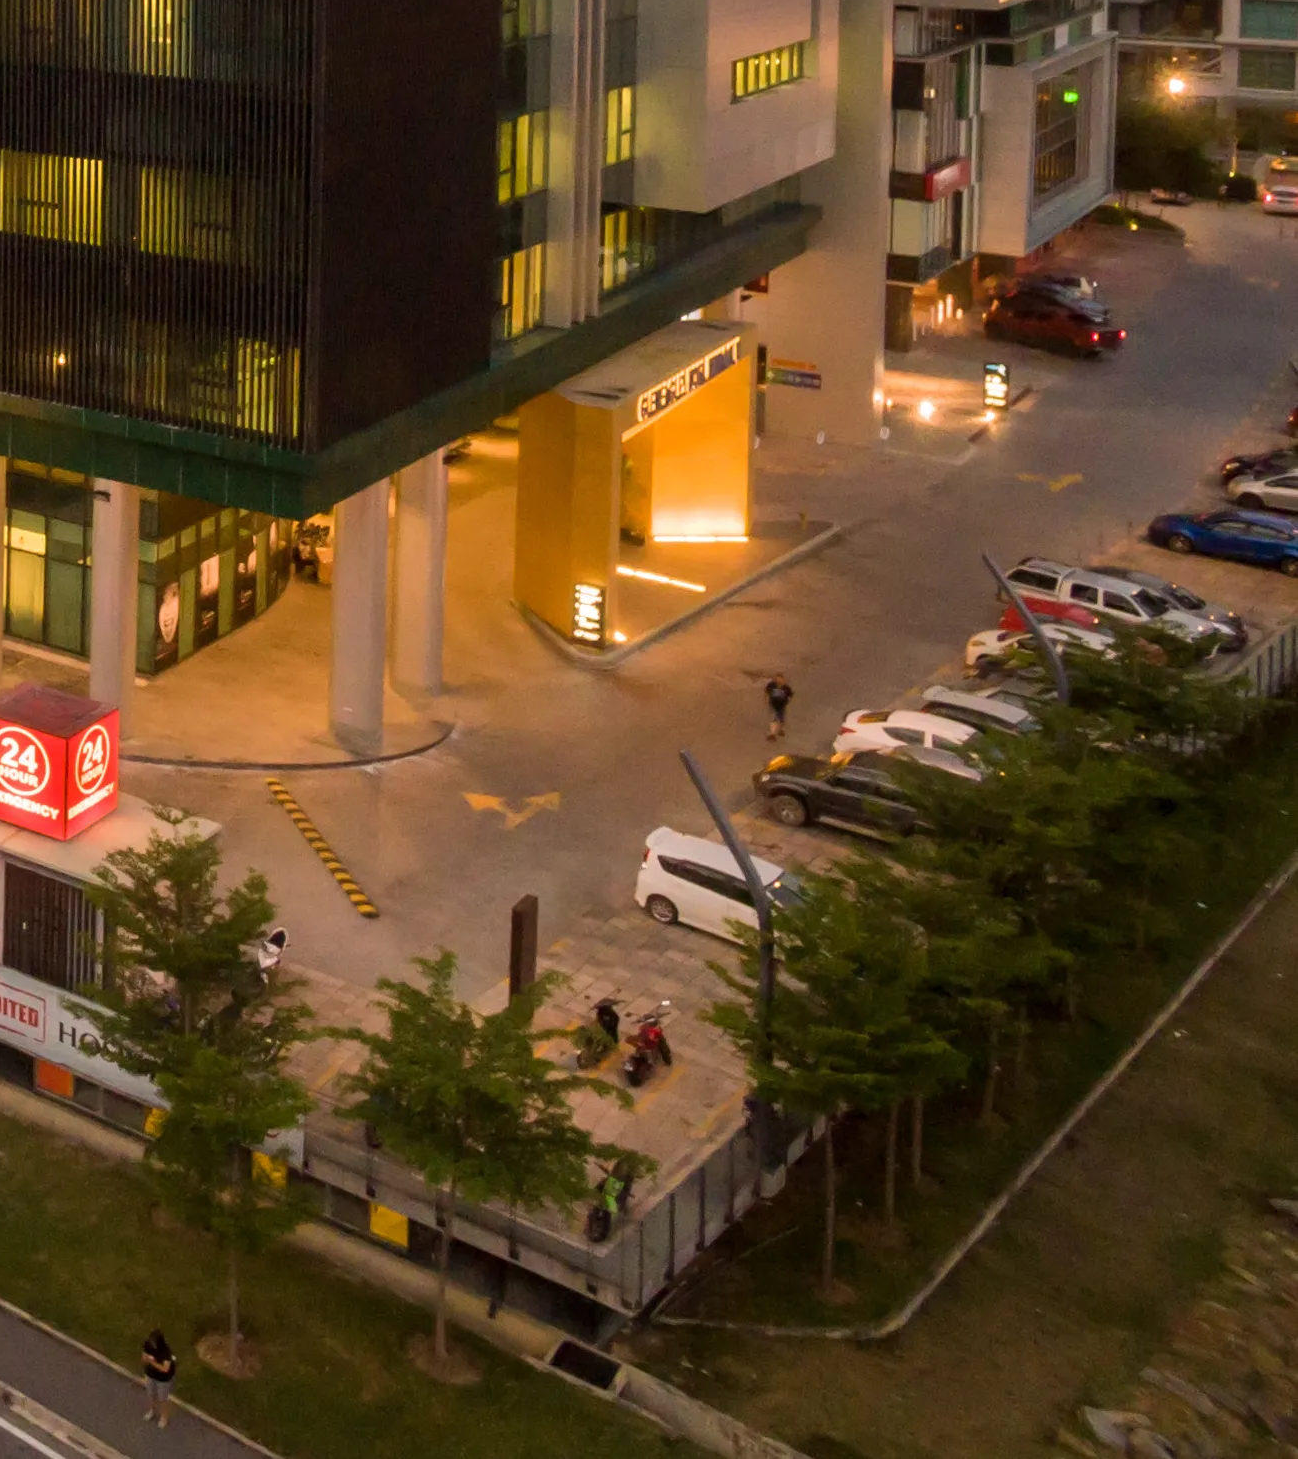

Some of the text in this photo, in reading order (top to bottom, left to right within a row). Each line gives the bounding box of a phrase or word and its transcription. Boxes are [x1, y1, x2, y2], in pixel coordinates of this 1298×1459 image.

[0, 737, 39, 773] 24
[82, 735, 103, 772] 24
[0, 764, 39, 788] HOUR
[81, 763, 104, 785] HOUR
